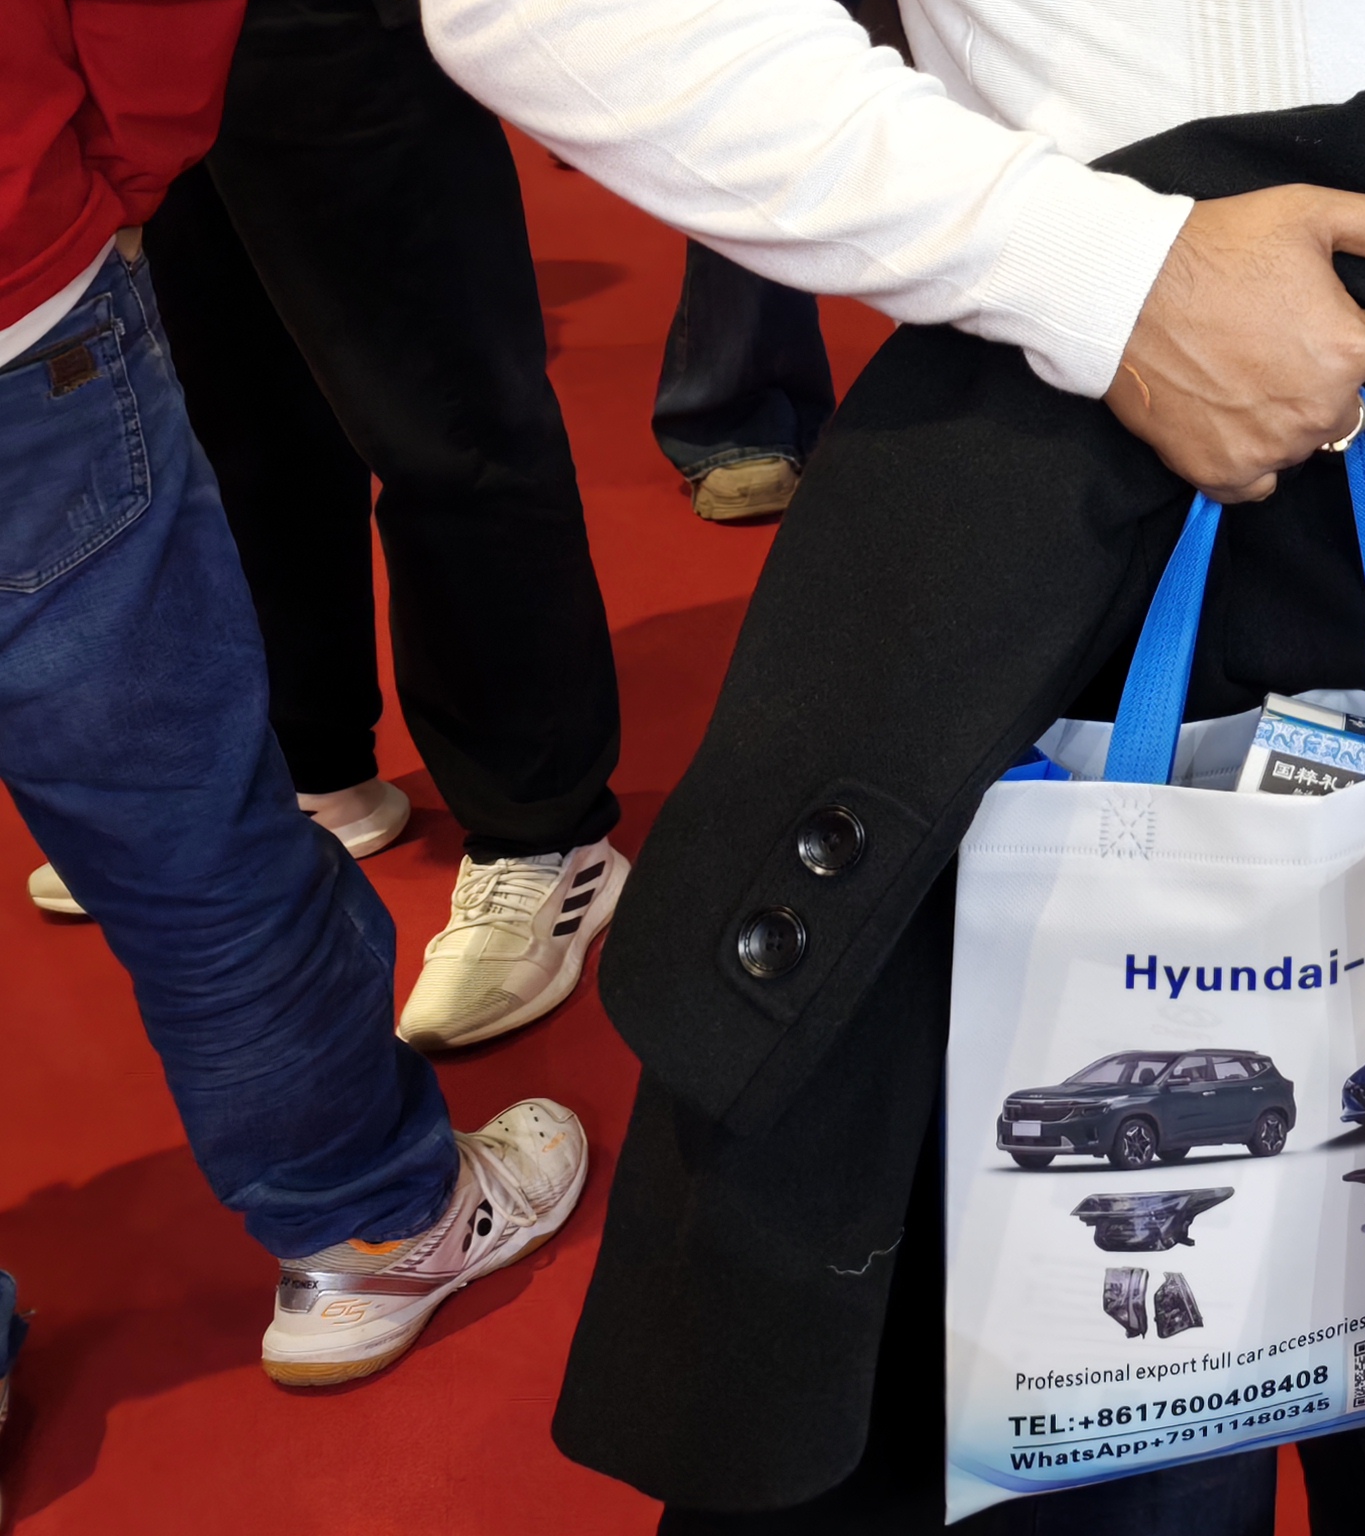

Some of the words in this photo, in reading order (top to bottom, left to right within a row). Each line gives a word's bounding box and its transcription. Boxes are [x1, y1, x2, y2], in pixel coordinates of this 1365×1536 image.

[1272, 760, 1359, 791] 国粹礼
[291, 1280, 319, 1290] YONEX
[1015, 1364, 1131, 1392] Professional
[1135, 1359, 1197, 1382] export
[1201, 1353, 1231, 1372] full
[1237, 1347, 1265, 1367] car
[1009, 1365, 1329, 1437] TEL:+8617600408408
[1010, 1397, 1331, 1472] WhatsApp+79111480345
